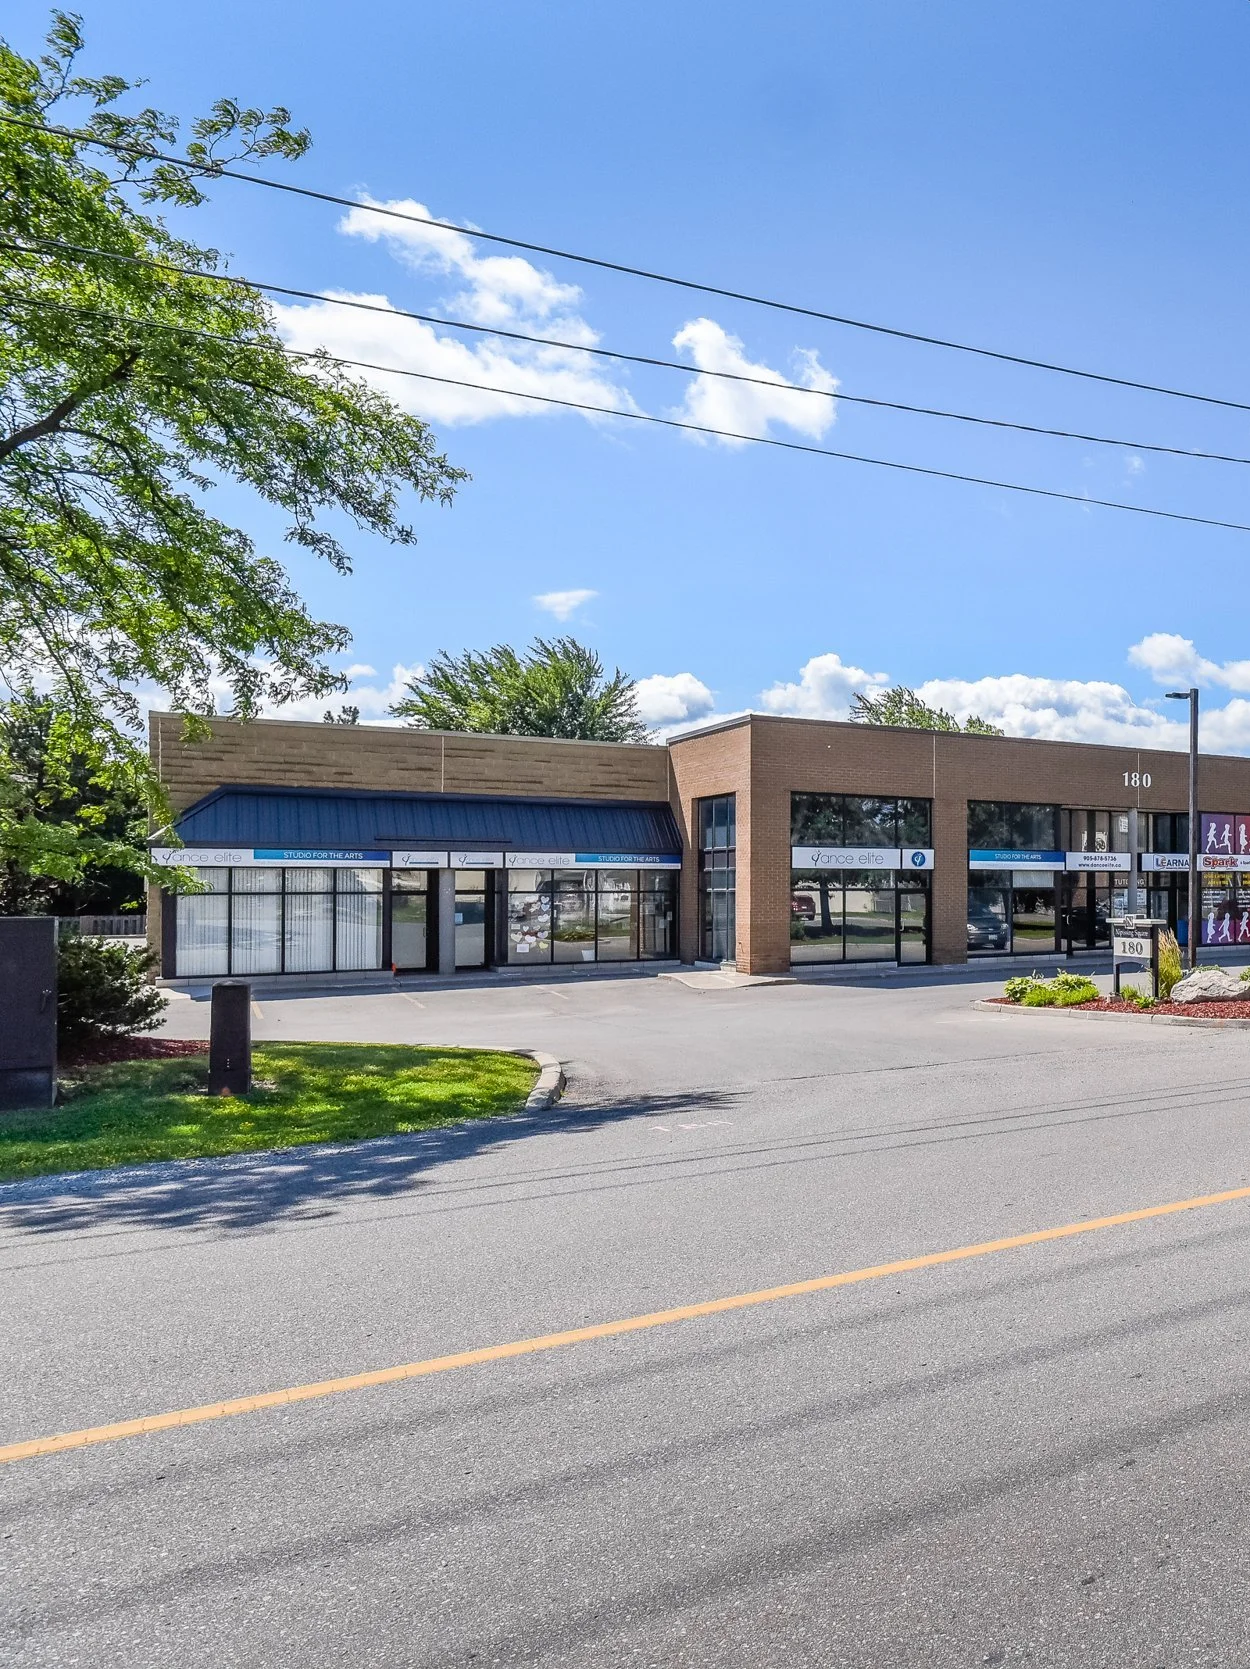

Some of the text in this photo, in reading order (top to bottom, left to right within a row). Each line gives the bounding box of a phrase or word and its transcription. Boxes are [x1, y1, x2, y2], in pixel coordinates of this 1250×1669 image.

[1122, 771, 1152, 788] 180
[214, 852, 242, 862] elite
[283, 851, 312, 859] STUDIO
[329, 852, 344, 860] THE
[344, 852, 364, 860] ARTS
[548, 855, 570, 866] elite
[858, 852, 884, 865] elite
[1156, 857, 1189, 867] LEARNA
[1203, 856, 1239, 870] Spark
[1114, 878, 1145, 886] TUTONG
[1134, 930, 1148, 938] Square
[1121, 942, 1143, 955] 180
